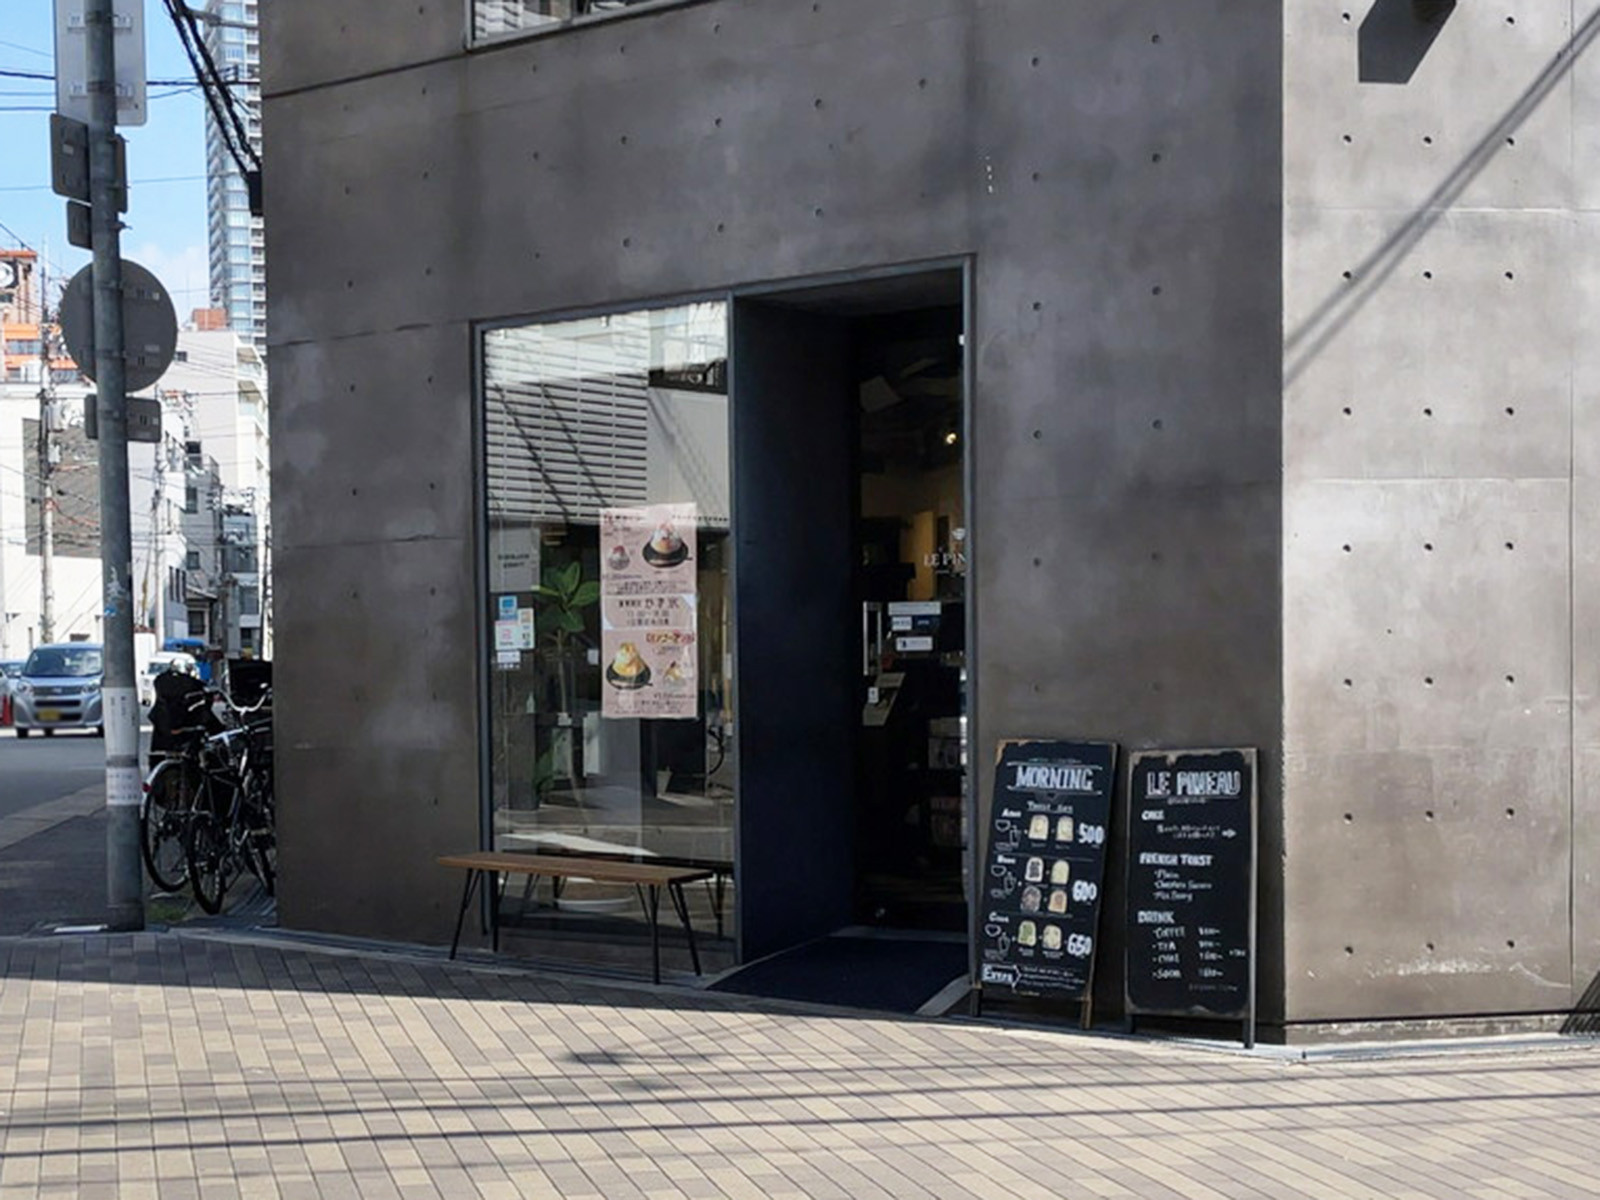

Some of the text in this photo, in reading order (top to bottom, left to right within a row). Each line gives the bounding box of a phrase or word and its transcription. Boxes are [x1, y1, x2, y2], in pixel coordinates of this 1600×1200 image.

[1015, 766, 1093, 791] MORNING
[1147, 770, 1241, 796] LE PINEAU
[1137, 911, 1176, 924] DRINK
